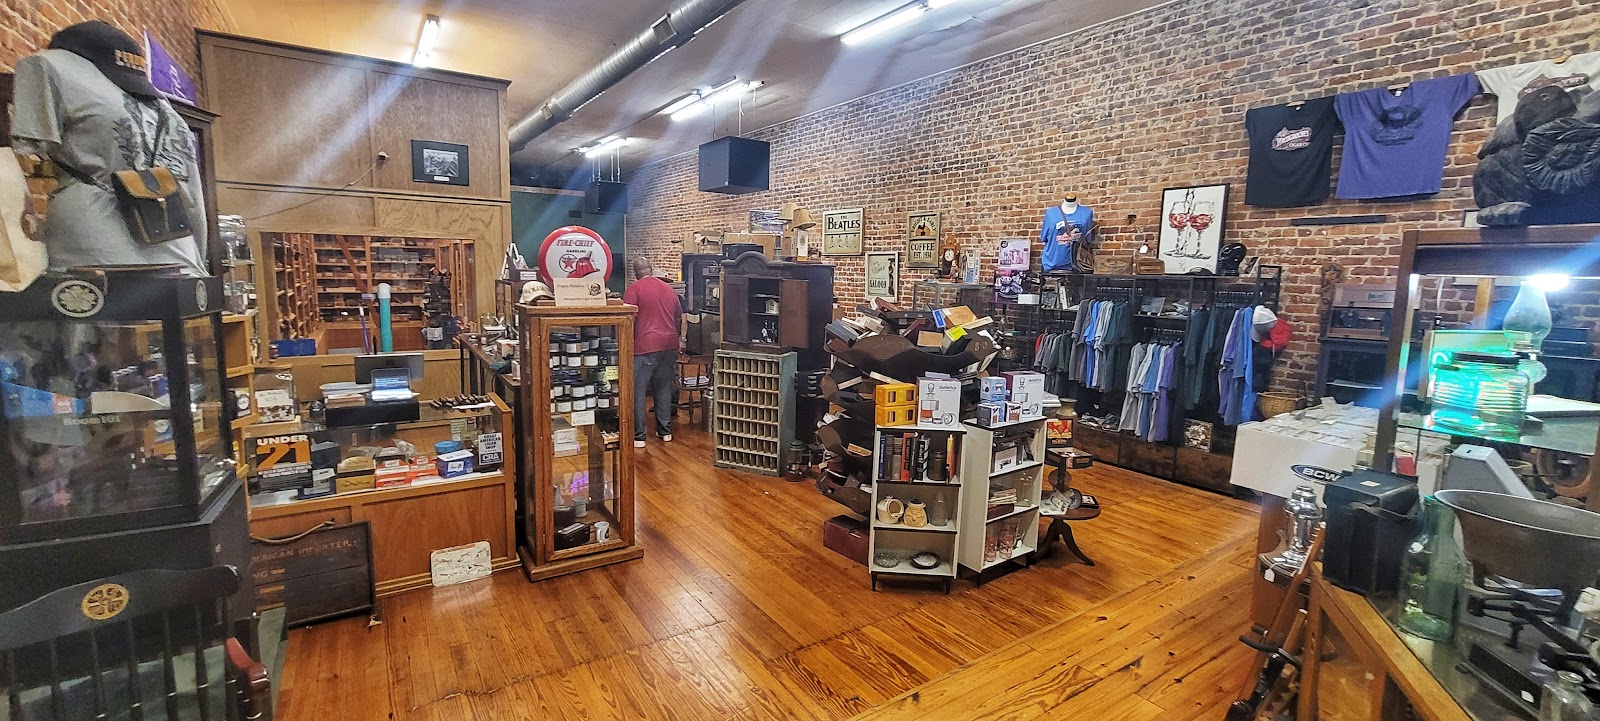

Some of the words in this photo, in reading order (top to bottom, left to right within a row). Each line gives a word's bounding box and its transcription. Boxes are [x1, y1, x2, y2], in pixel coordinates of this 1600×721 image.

[828, 216, 860, 231] BEATLES
[910, 242, 935, 251] COFFEE
[256, 434, 308, 446] UNDER
[256, 441, 311, 471] 21
[1302, 467, 1341, 482] BCW
